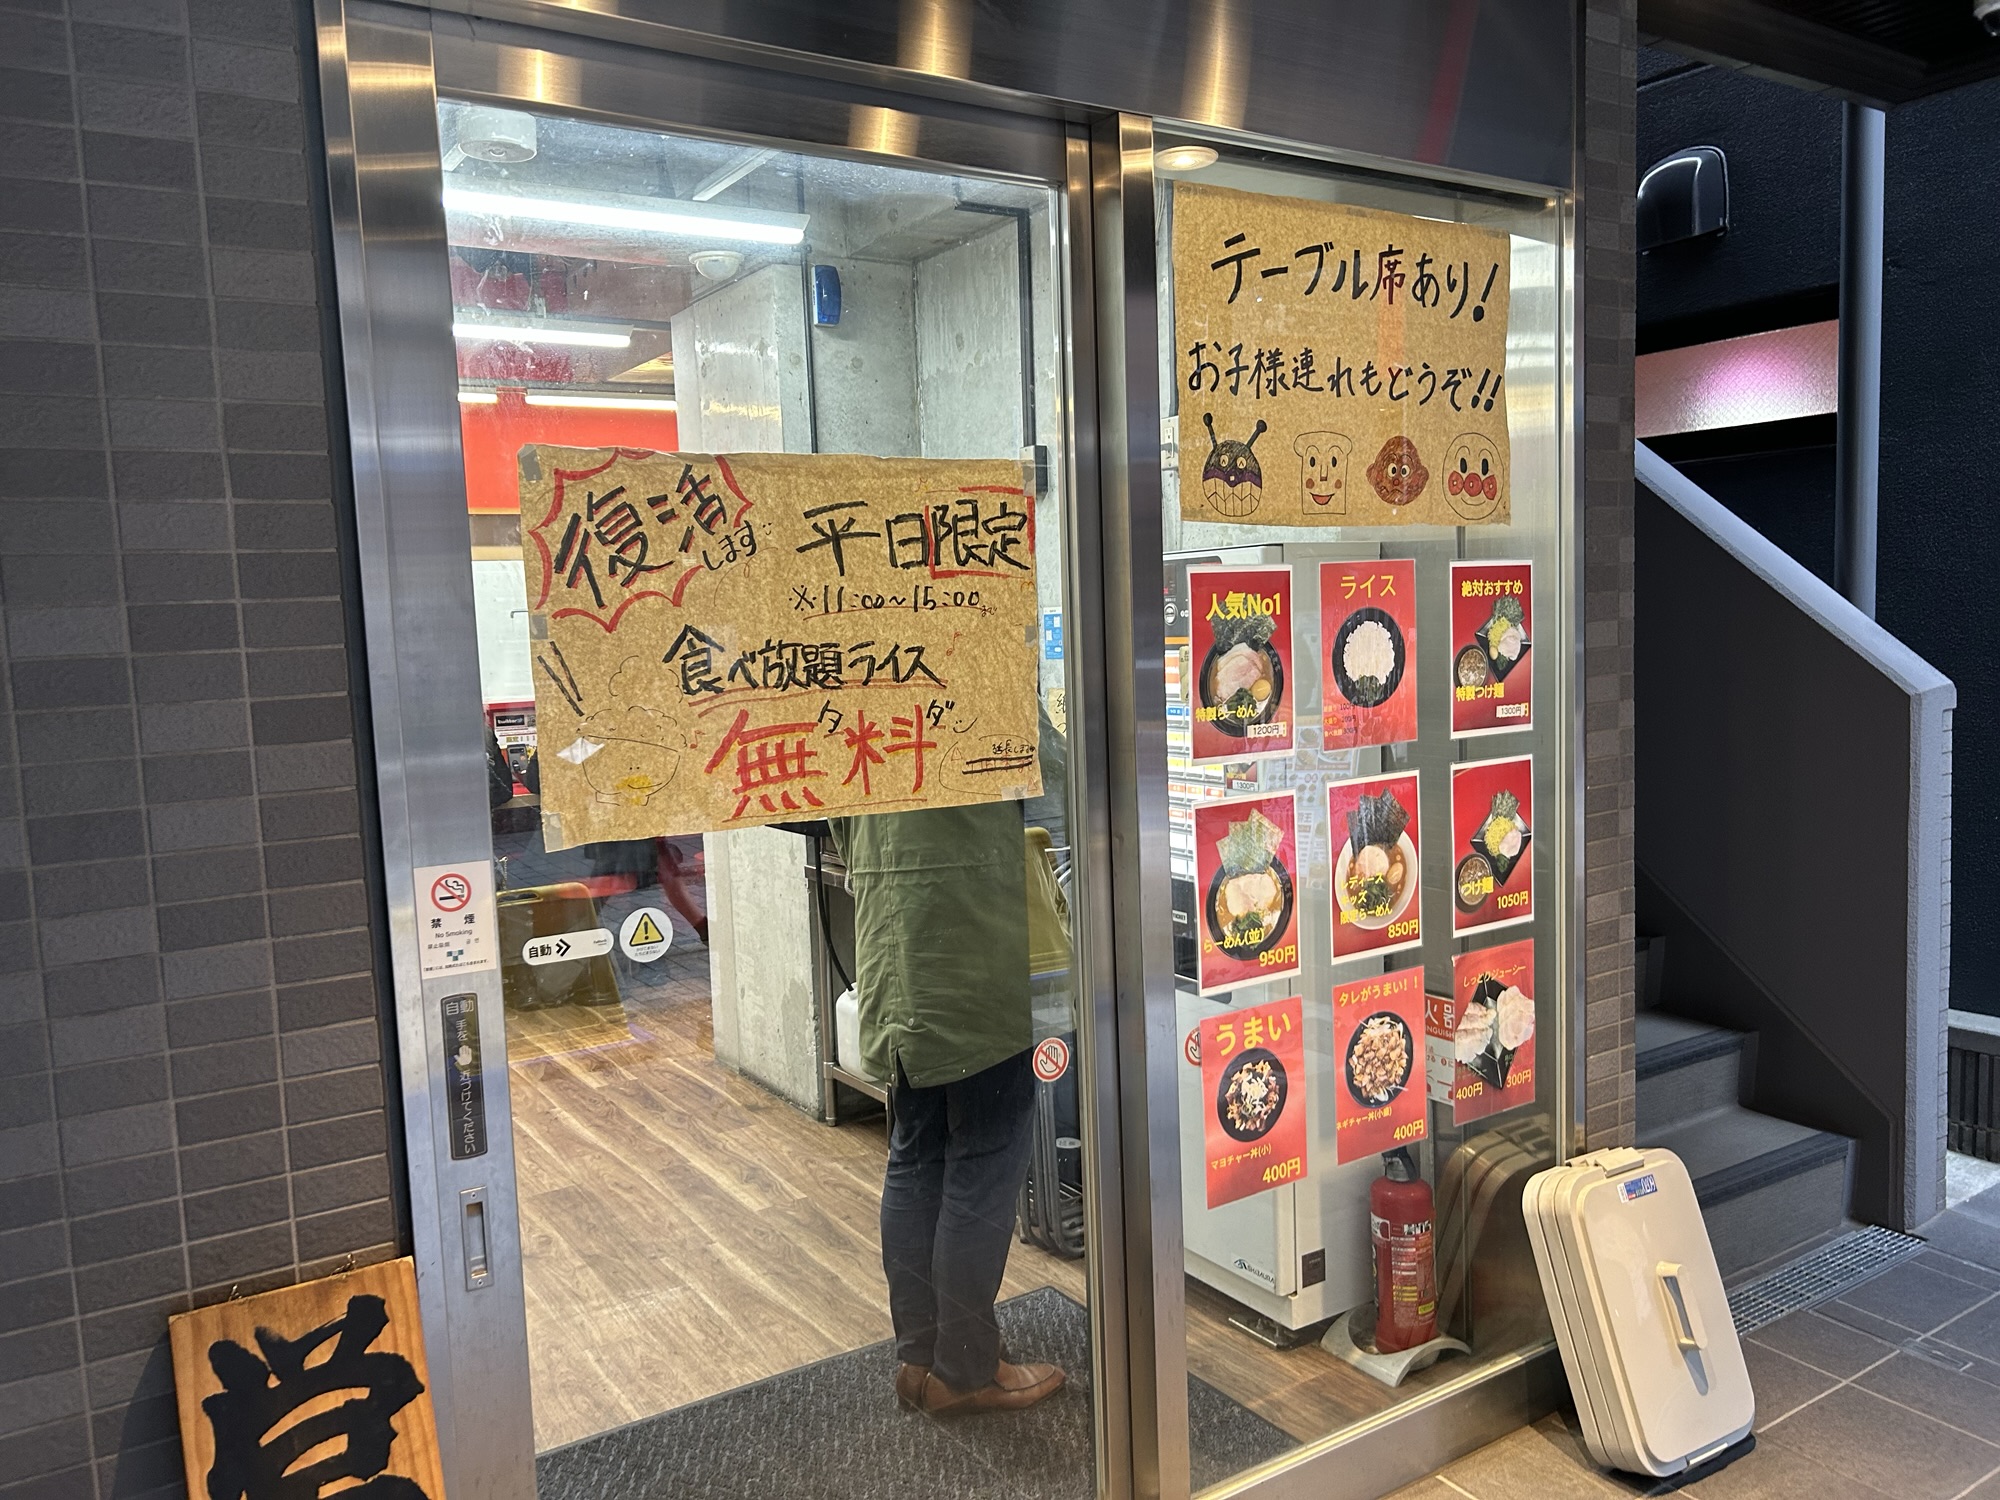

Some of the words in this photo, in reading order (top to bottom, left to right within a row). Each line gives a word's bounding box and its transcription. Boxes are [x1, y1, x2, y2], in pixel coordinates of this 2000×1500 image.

[1211, 232, 1499, 322] テーブル席あり!
[1188, 340, 1502, 412] お子様連れもどうぞ!!
[554, 463, 728, 608] 復活
[702, 520, 757, 571] します
[796, 499, 1031, 577] 平日限定
[1340, 574, 1397, 600] ライス
[1461, 579, 1524, 597] 絶対おすすめ
[662, 624, 948, 697] 食べ放題ライス
[1195, 704, 1258, 722] 特製らーめん
[1253, 724, 1280, 736] 1200円
[704, 703, 938, 820] 無料
[1497, 890, 1529, 910] 1050円
[446, 929, 473, 937] Smoking
[1388, 919, 1419, 939] 850円
[528, 943, 552, 959] 自動
[1259, 944, 1296, 967] 950円
[1463, 964, 1527, 988] しっとりジューシー
[446, 999, 475, 1015] 自動
[1216, 1011, 1291, 1056] うまい
[1506, 1069, 1532, 1088] 300円
[1456, 1081, 1483, 1100] 400円
[1393, 1118, 1424, 1141] 400円
[1262, 1157, 1301, 1183] 400円
